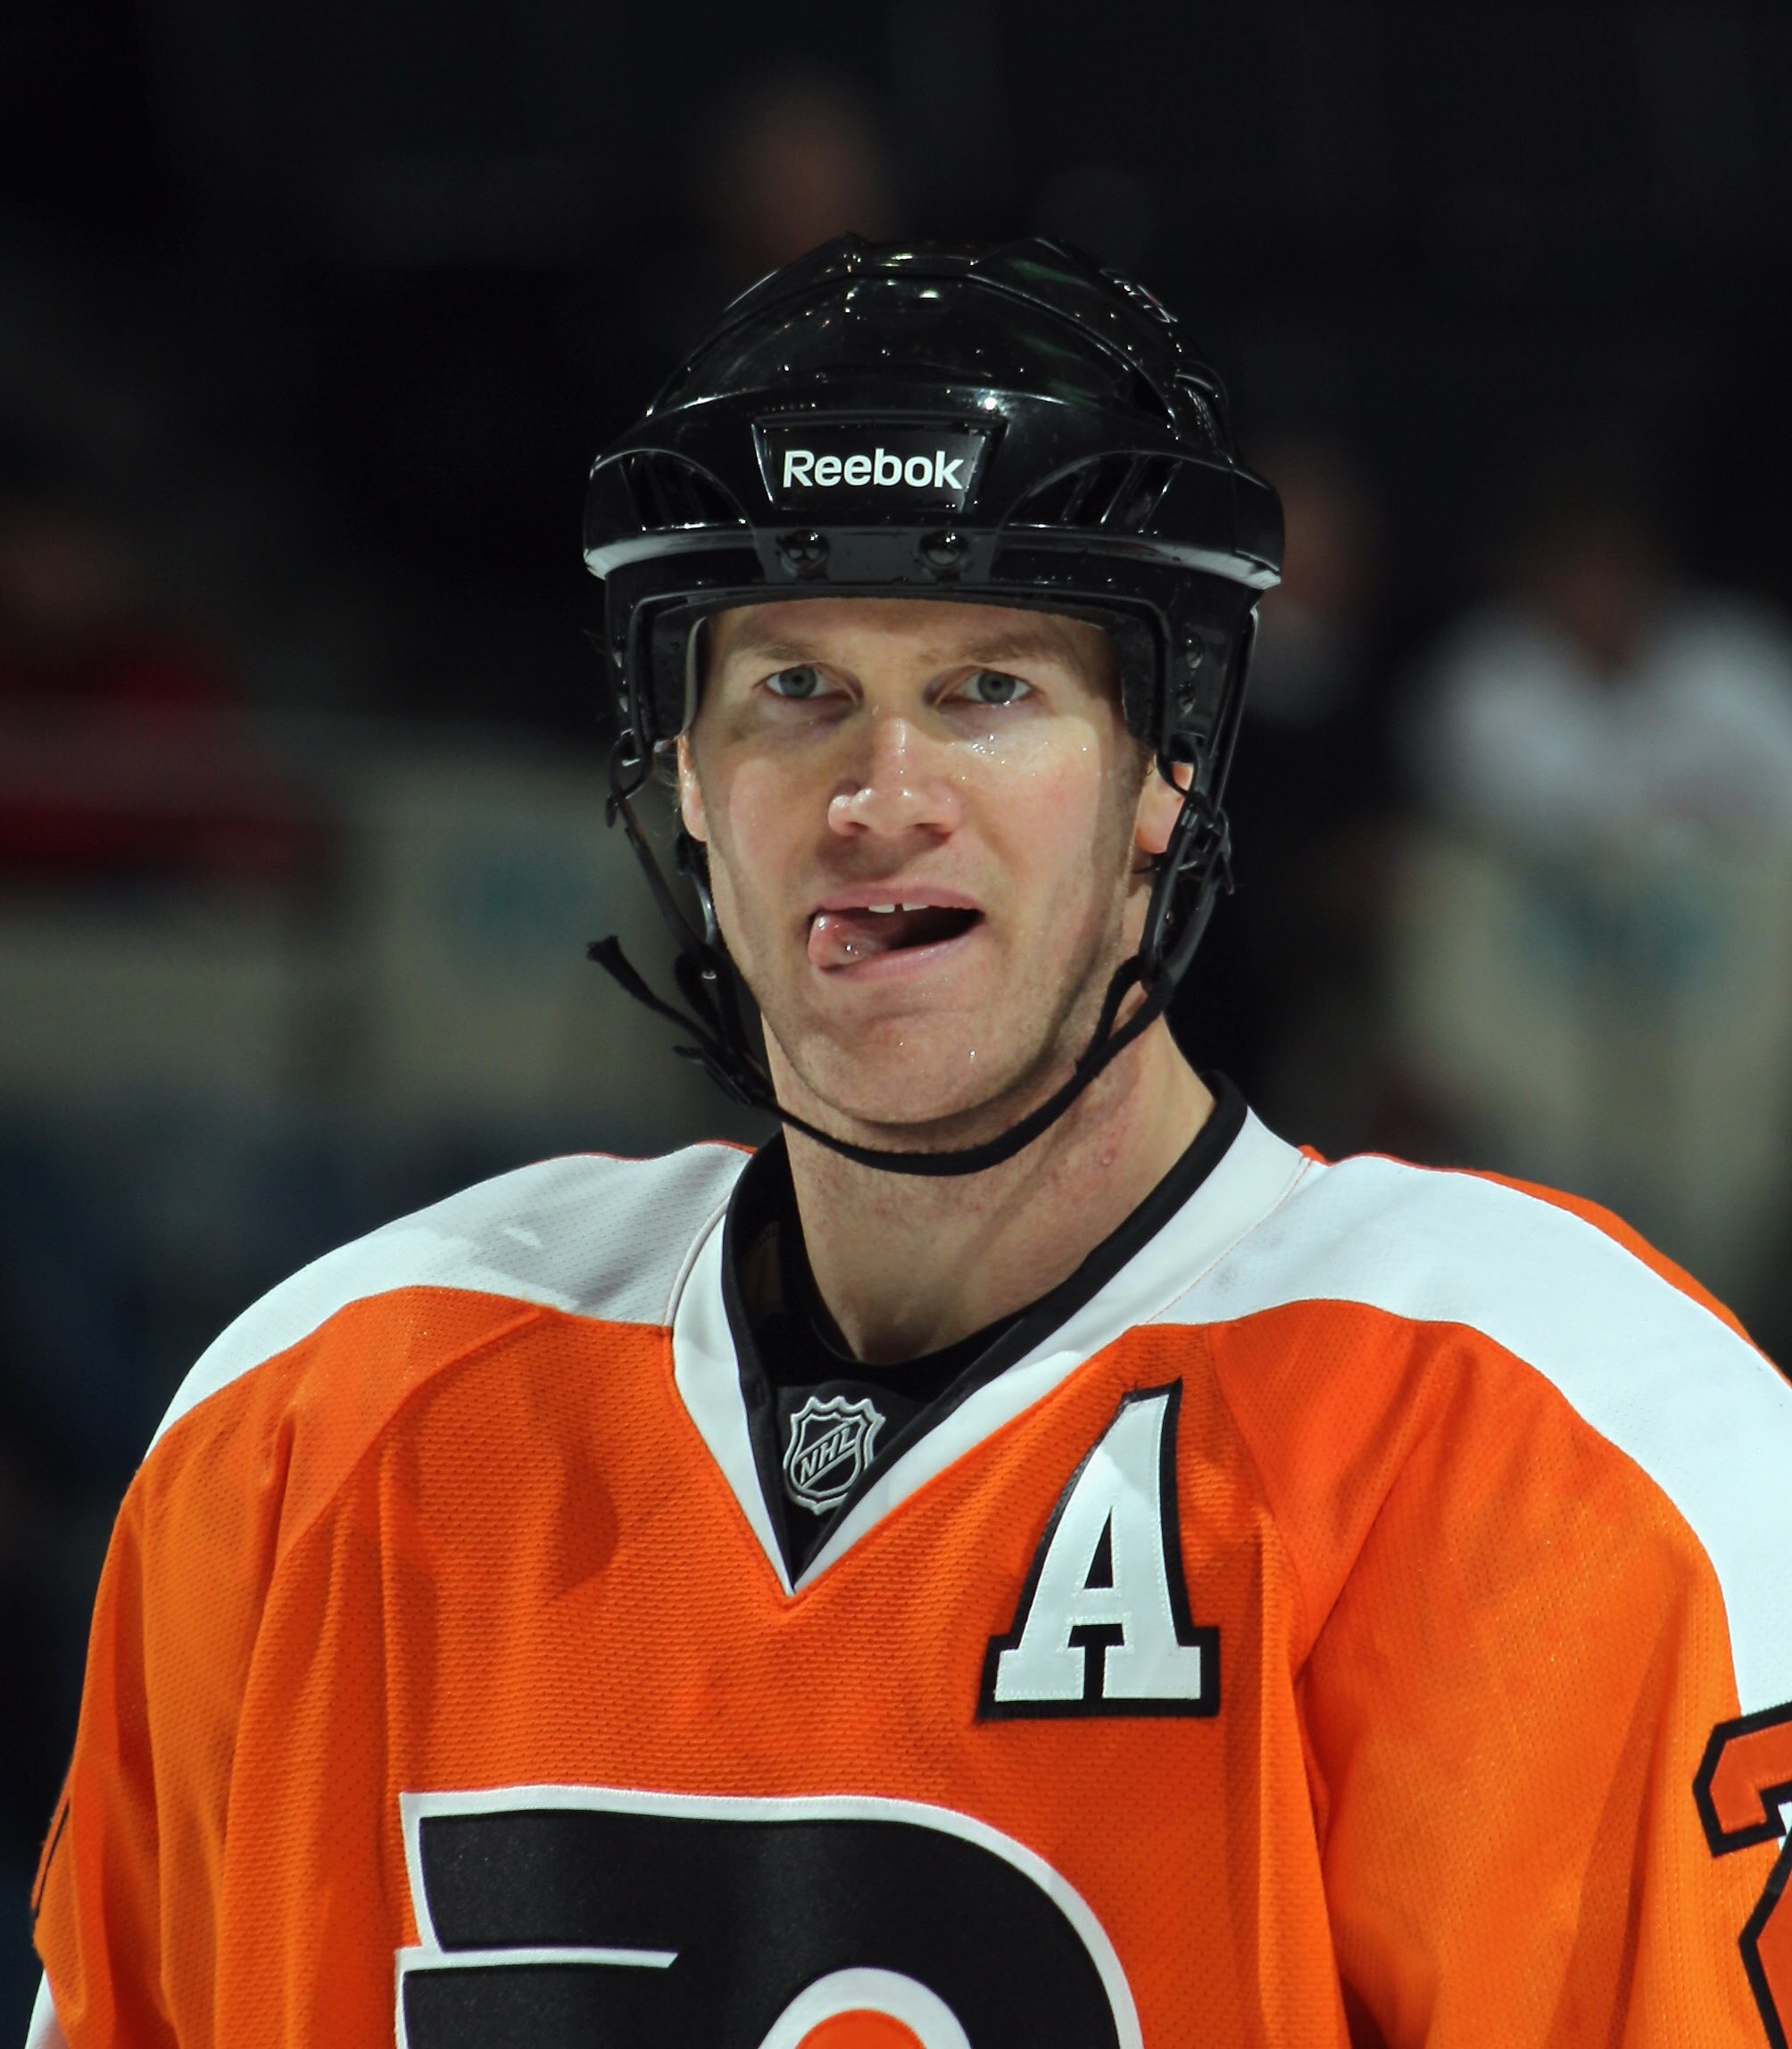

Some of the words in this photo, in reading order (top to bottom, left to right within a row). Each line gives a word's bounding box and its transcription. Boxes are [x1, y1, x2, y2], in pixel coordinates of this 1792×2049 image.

[782, 447, 967, 491] Reebok
[799, 1427, 858, 1485] NHL
[978, 1380, 1217, 1719] A
